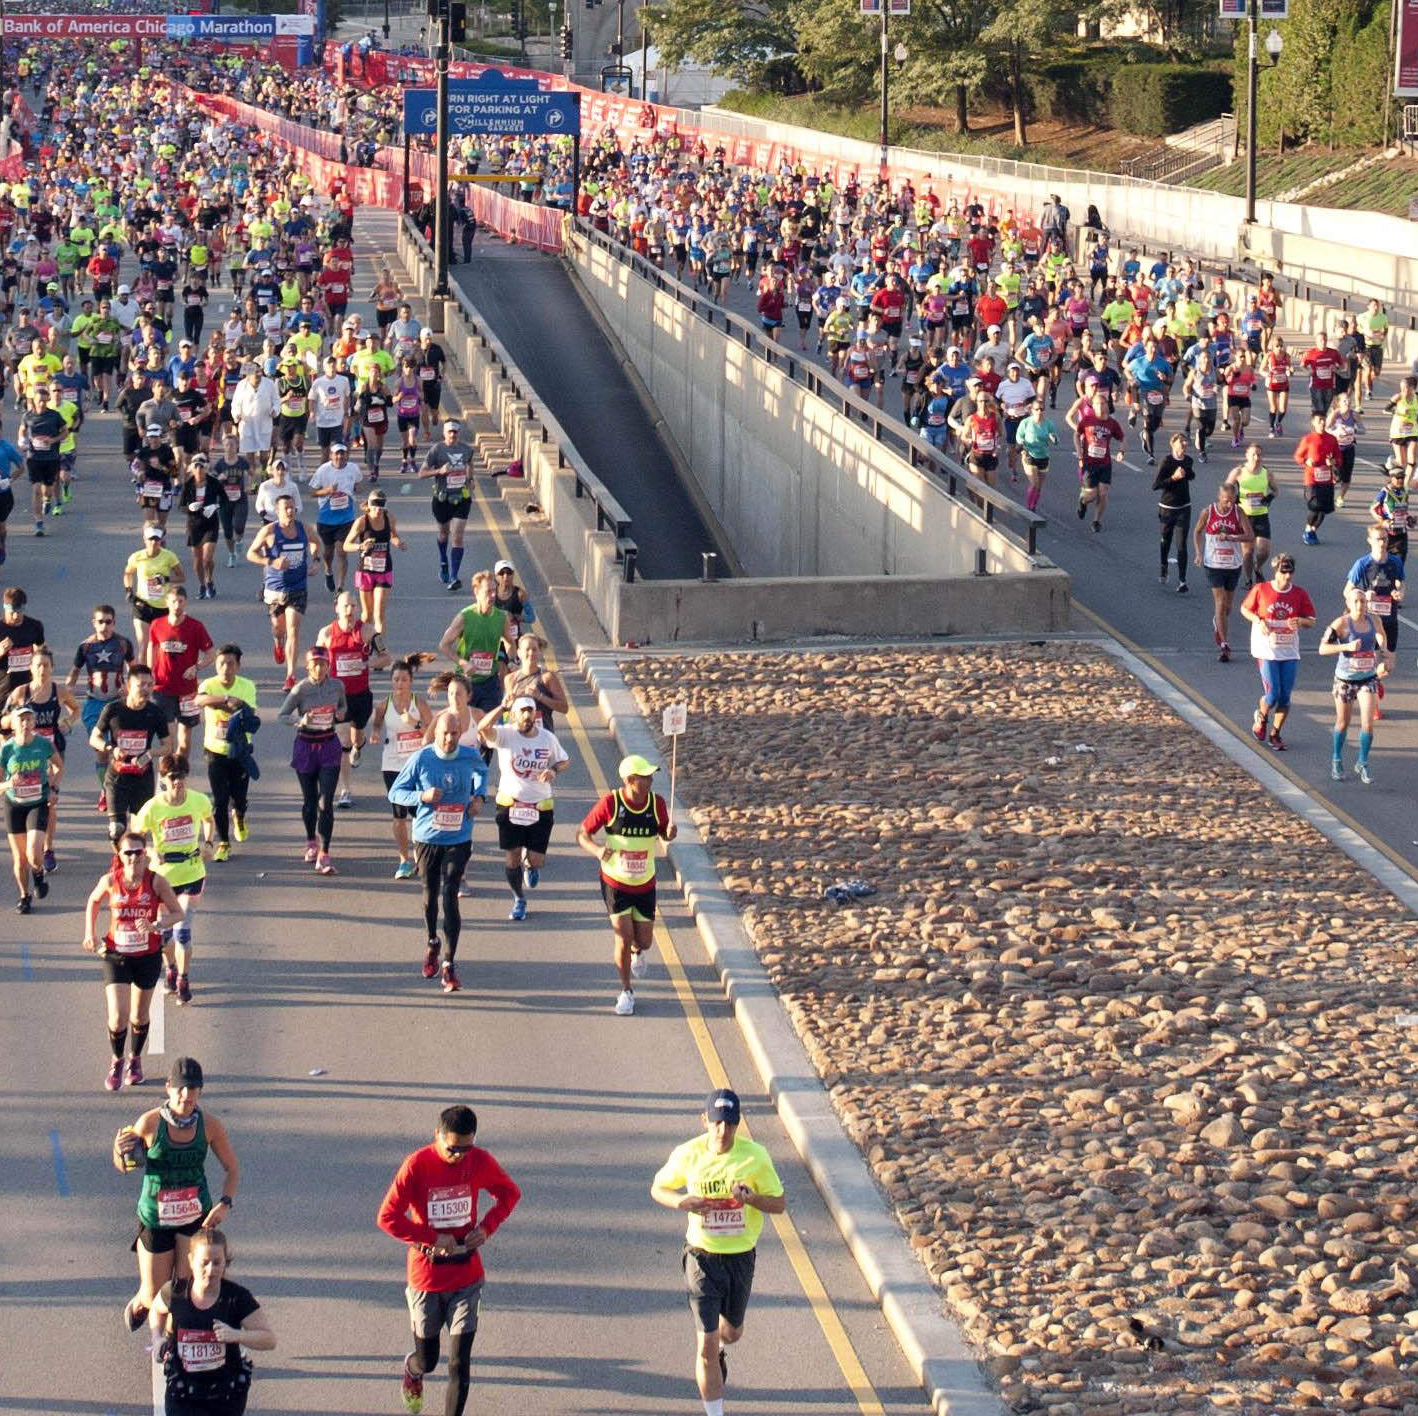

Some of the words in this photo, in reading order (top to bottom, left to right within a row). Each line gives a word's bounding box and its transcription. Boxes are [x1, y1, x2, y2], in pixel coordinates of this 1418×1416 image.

[4, 19, 41, 33] Bank
[47, 19, 63, 33] of
[68, 19, 130, 33] America
[135, 19, 195, 37] Chicago
[200, 20, 272, 34] Marathon
[467, 95, 499, 103] RIGHT
[502, 95, 516, 103] AT
[519, 95, 551, 104] LIGHT
[448, 105, 470, 113] FOR
[473, 105, 520, 114] PARKING
[523, 106, 538, 114] AT
[410, 190, 423, 200] TOP
[1267, 601, 1293, 614] ITALIA
[621, 827, 650, 835] PACER
[432, 1204, 438, 1215] E
[440, 1200, 469, 1215] 15300
[704, 1212, 709, 1223] E
[713, 1211, 741, 1223] 14723
[181, 1347, 187, 1358] E
